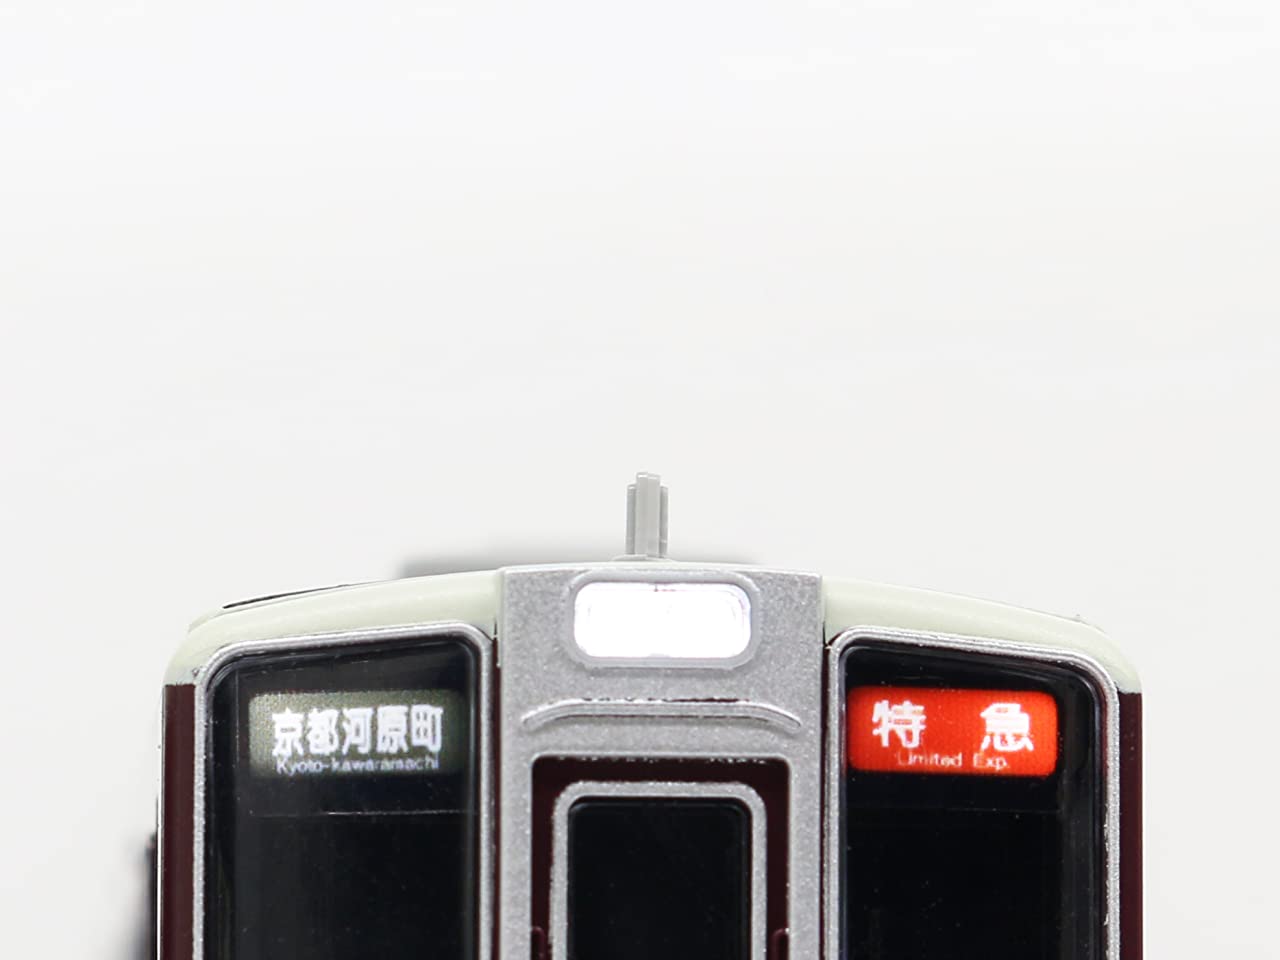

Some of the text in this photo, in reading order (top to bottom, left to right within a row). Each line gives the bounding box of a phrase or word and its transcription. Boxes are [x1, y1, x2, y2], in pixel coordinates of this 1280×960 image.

[272, 704, 444, 756] 京都河原町
